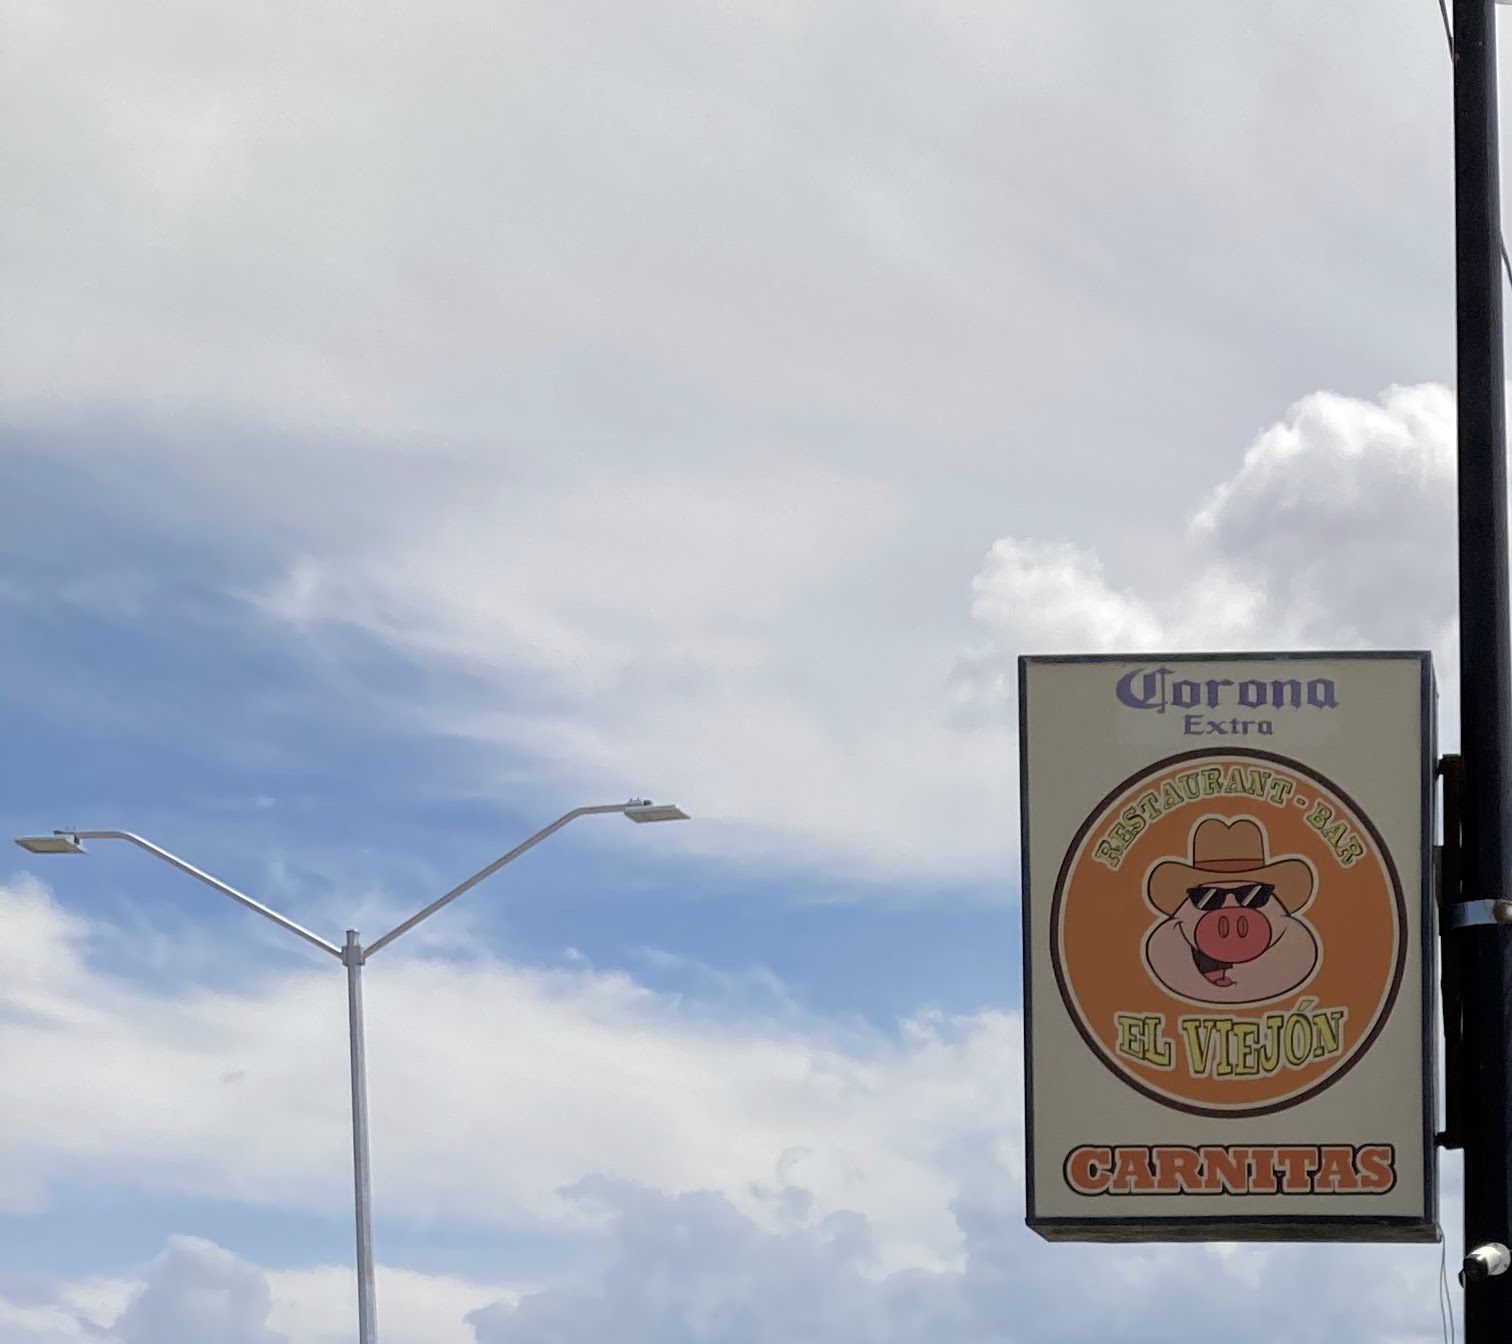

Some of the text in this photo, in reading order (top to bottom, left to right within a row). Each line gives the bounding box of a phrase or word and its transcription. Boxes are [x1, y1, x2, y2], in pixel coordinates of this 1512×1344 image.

[1116, 667, 1340, 714] Corona
[1183, 714, 1274, 735] Extra
[1095, 768, 1293, 868] RESTAURANT
[1306, 802, 1364, 865] BAR
[1118, 999, 1344, 1076] EL VIEJÓN
[1065, 1145, 1396, 1195] CARNITAS
